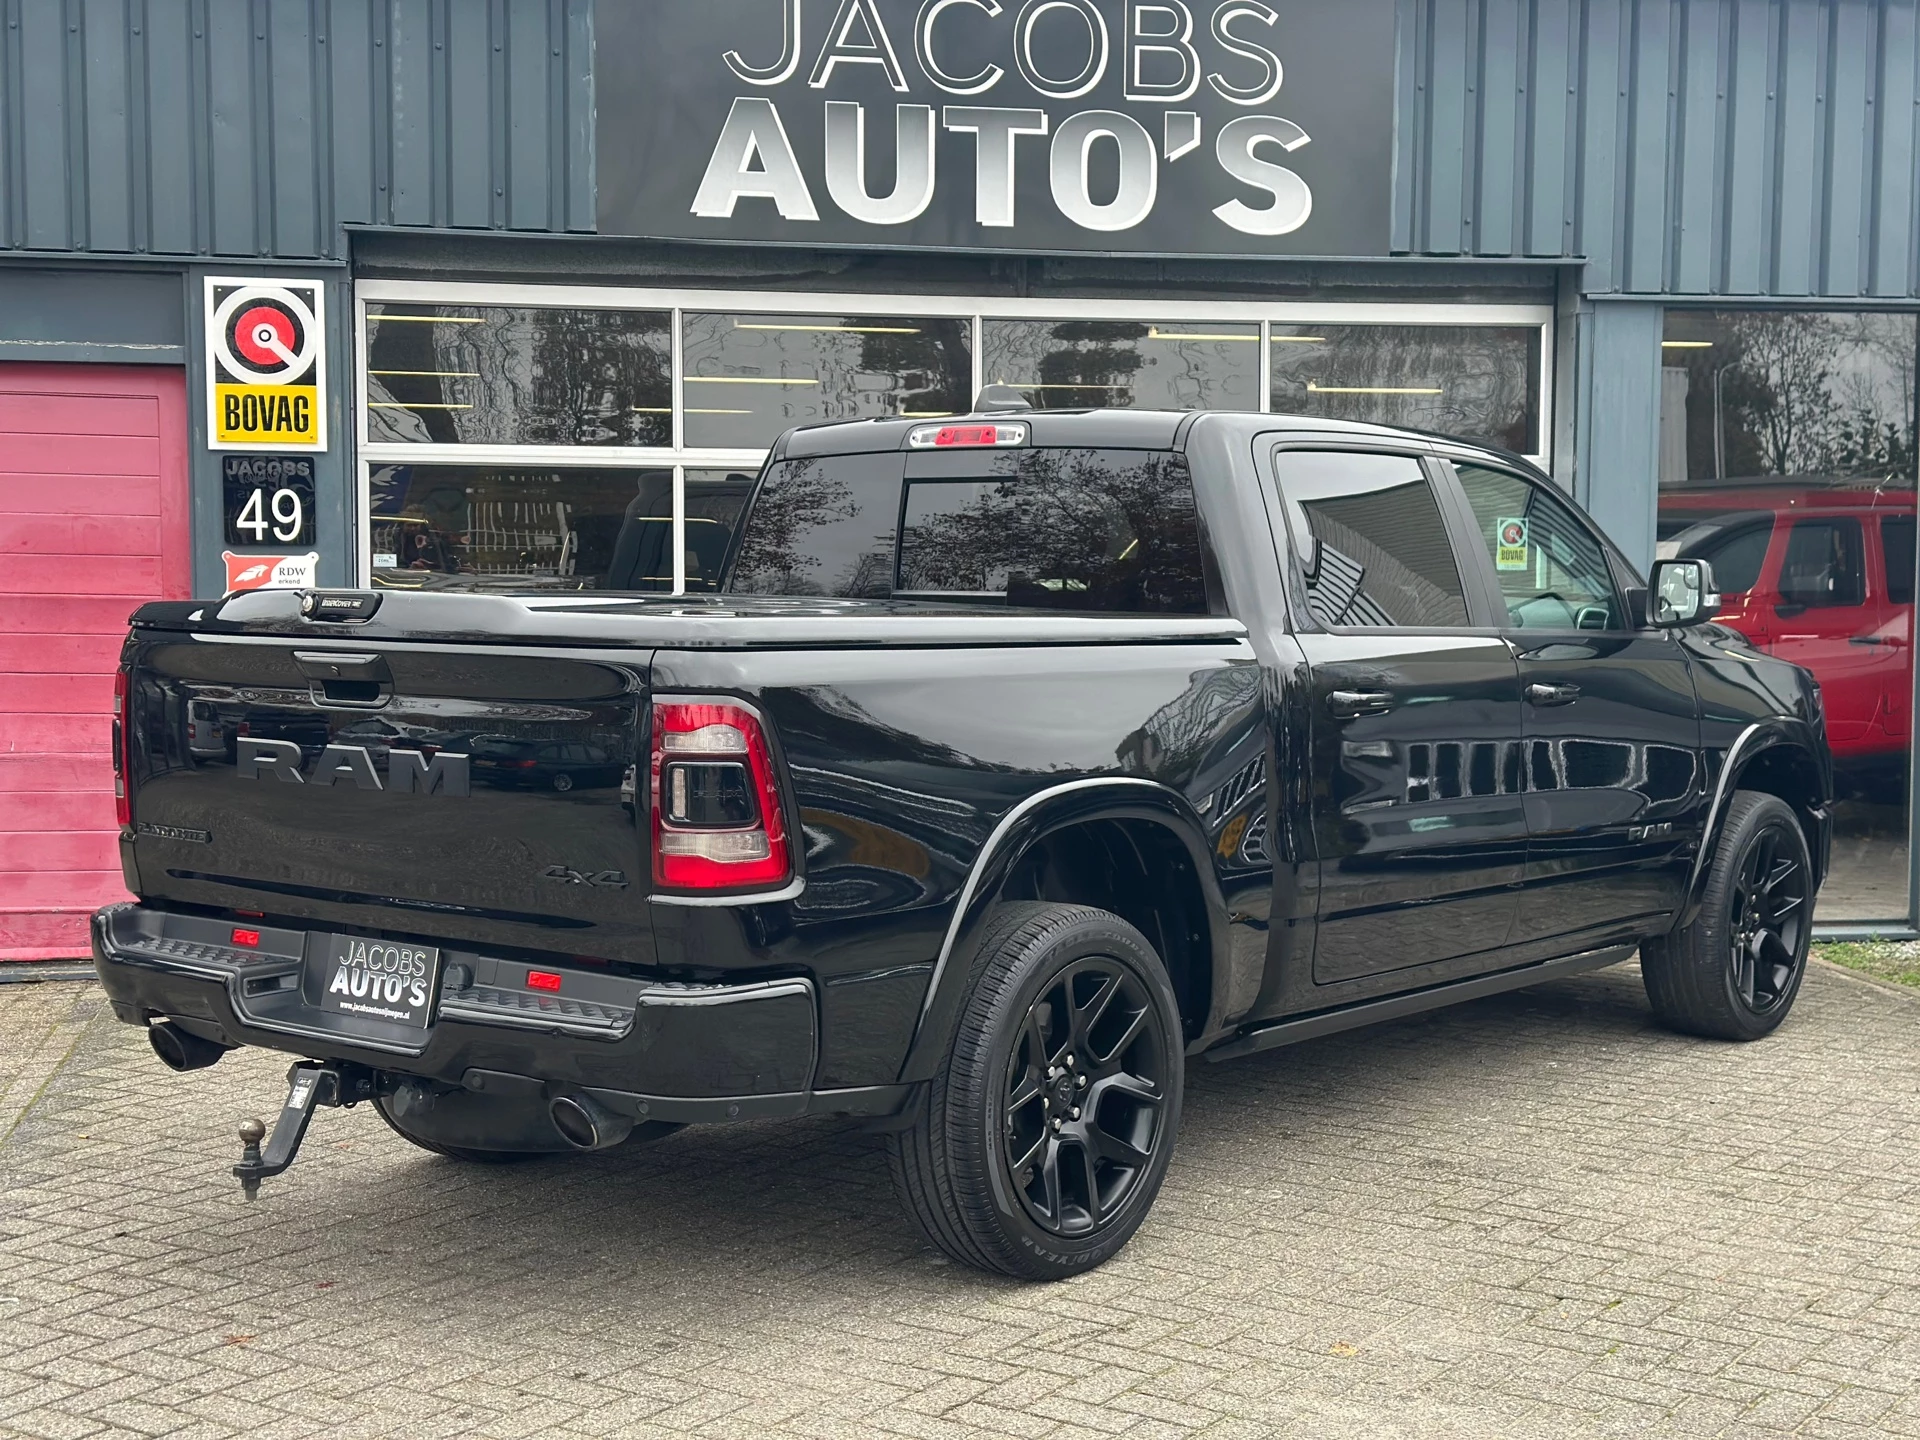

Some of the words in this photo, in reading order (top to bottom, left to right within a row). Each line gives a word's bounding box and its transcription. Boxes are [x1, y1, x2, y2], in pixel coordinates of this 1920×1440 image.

[722, 0, 1284, 105] JACOBS
[690, 96, 1313, 237] AUTO'S
[224, 393, 310, 433] BOVAG
[225, 460, 310, 477] JACOBS
[236, 488, 302, 542] 49
[278, 567, 307, 577] RDW
[1501, 549, 1524, 561] BOVAG
[236, 736, 471, 798] RAM
[1628, 822, 1672, 841] RAM
[339, 940, 426, 977] JACOBS
[329, 965, 428, 1008] AUTO'S
